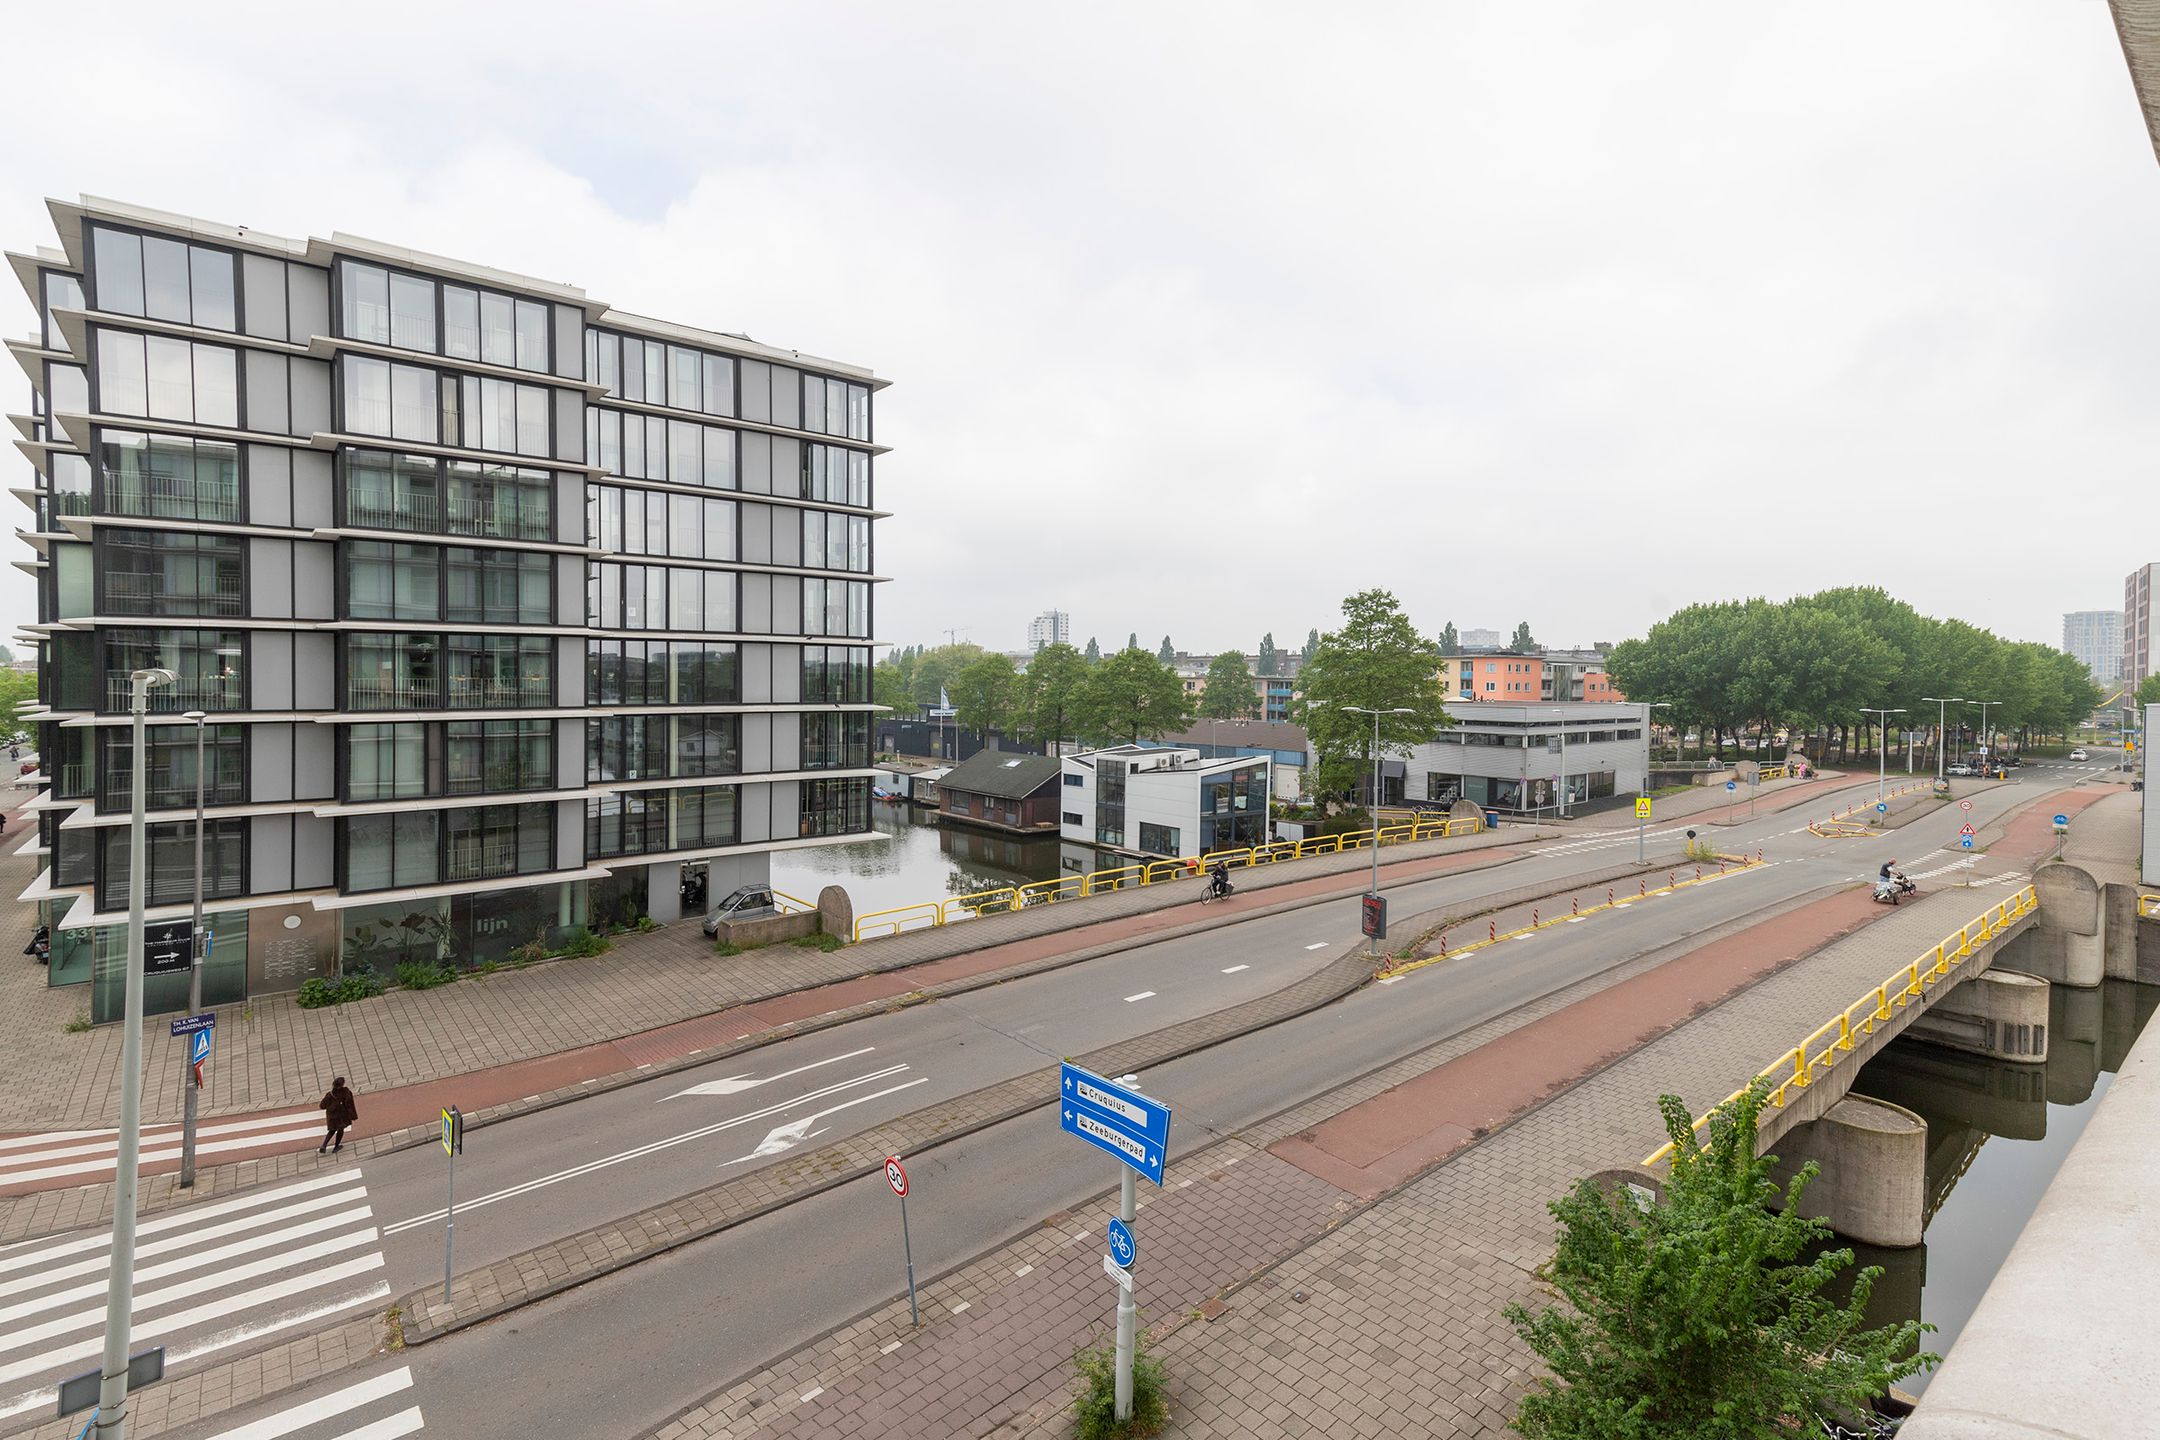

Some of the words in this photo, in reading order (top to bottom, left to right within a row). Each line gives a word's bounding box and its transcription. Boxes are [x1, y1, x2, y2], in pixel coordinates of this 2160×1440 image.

[477, 918, 508, 934] lijn
[1089, 1088, 1126, 1112] Cruquius
[1089, 1121, 1144, 1157] Zeeburgerpad
[889, 1167, 903, 1187] 30
